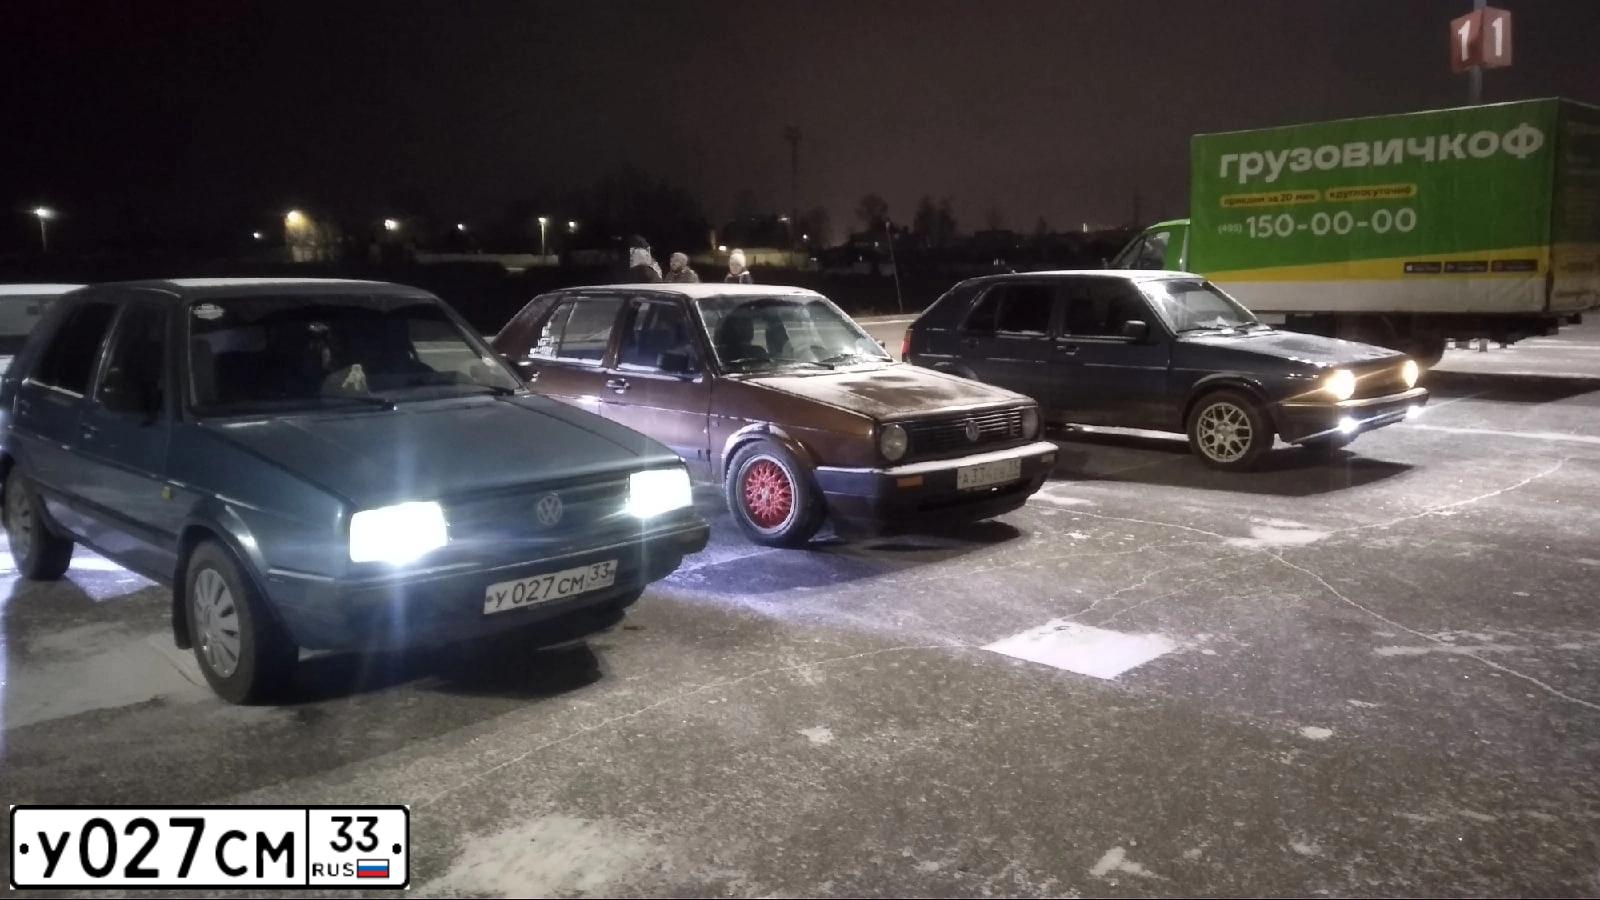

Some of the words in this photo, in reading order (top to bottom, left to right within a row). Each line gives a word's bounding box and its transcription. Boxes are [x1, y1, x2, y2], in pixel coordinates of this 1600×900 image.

[1457, 20, 1471, 62] 1
[1491, 16, 1503, 57] 1
[1280, 192, 1294, 202] 20
[1246, 207, 1417, 239] 150-00-00
[590, 562, 611, 581] 33
